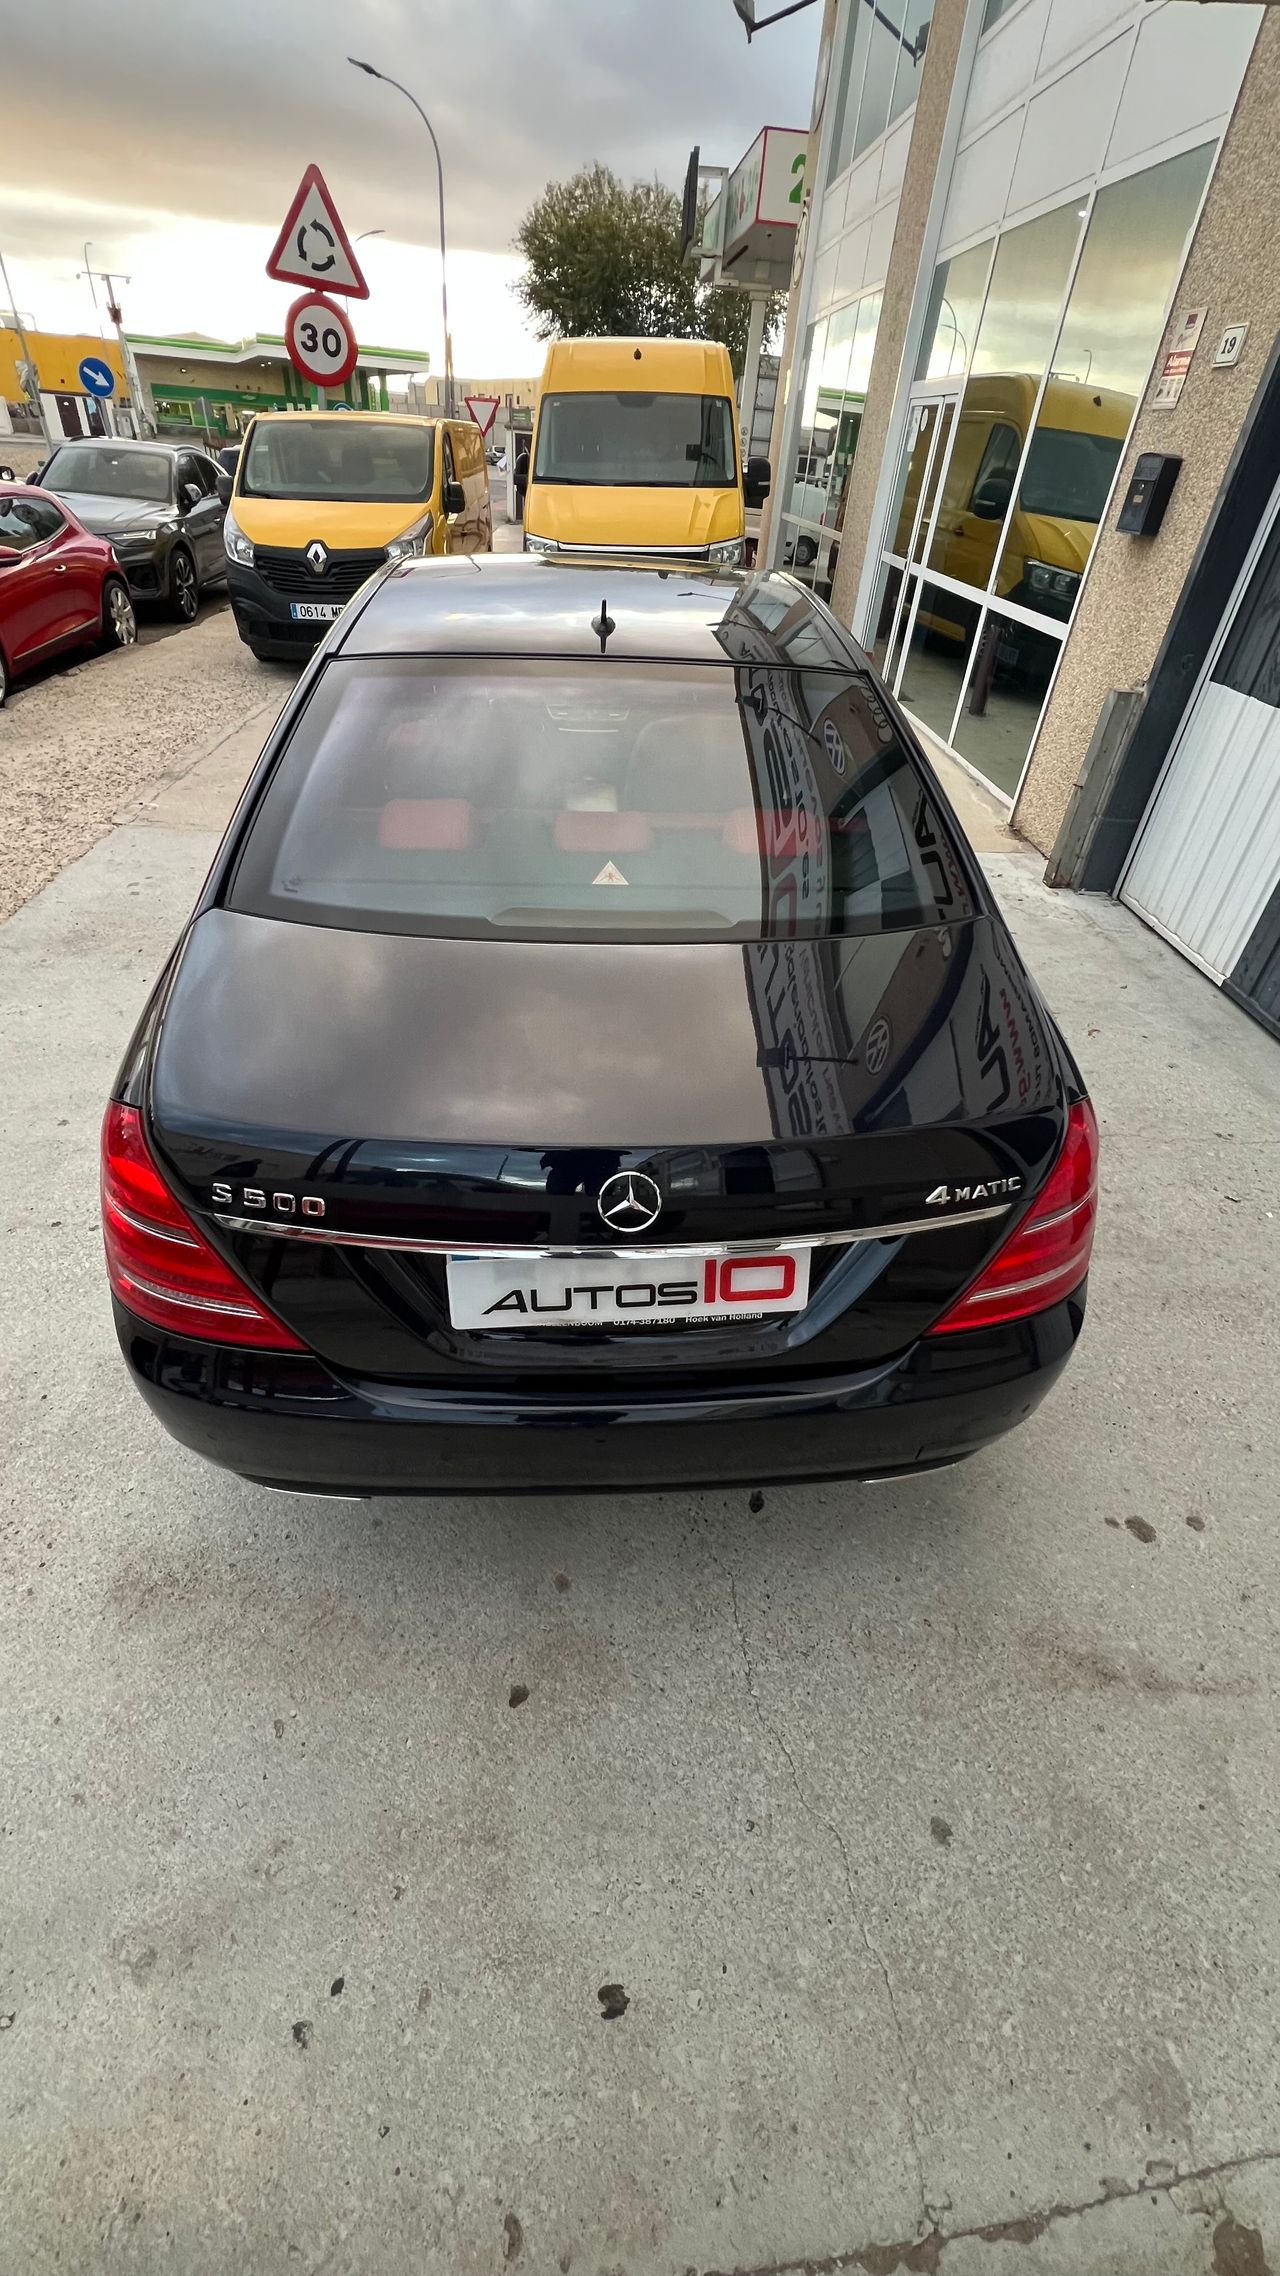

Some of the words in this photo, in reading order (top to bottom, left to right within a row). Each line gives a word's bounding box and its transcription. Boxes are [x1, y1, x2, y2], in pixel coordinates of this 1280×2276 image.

[300, 322, 342, 358] 30
[1220, 336, 1237, 355] 19
[300, 605, 327, 618] 0614
[211, 1182, 233, 1204] S
[243, 1187, 326, 1217] 500
[685, 1315, 709, 1323] Hoek
[711, 1314, 728, 1322] van
[729, 1312, 764, 1321] Holland
